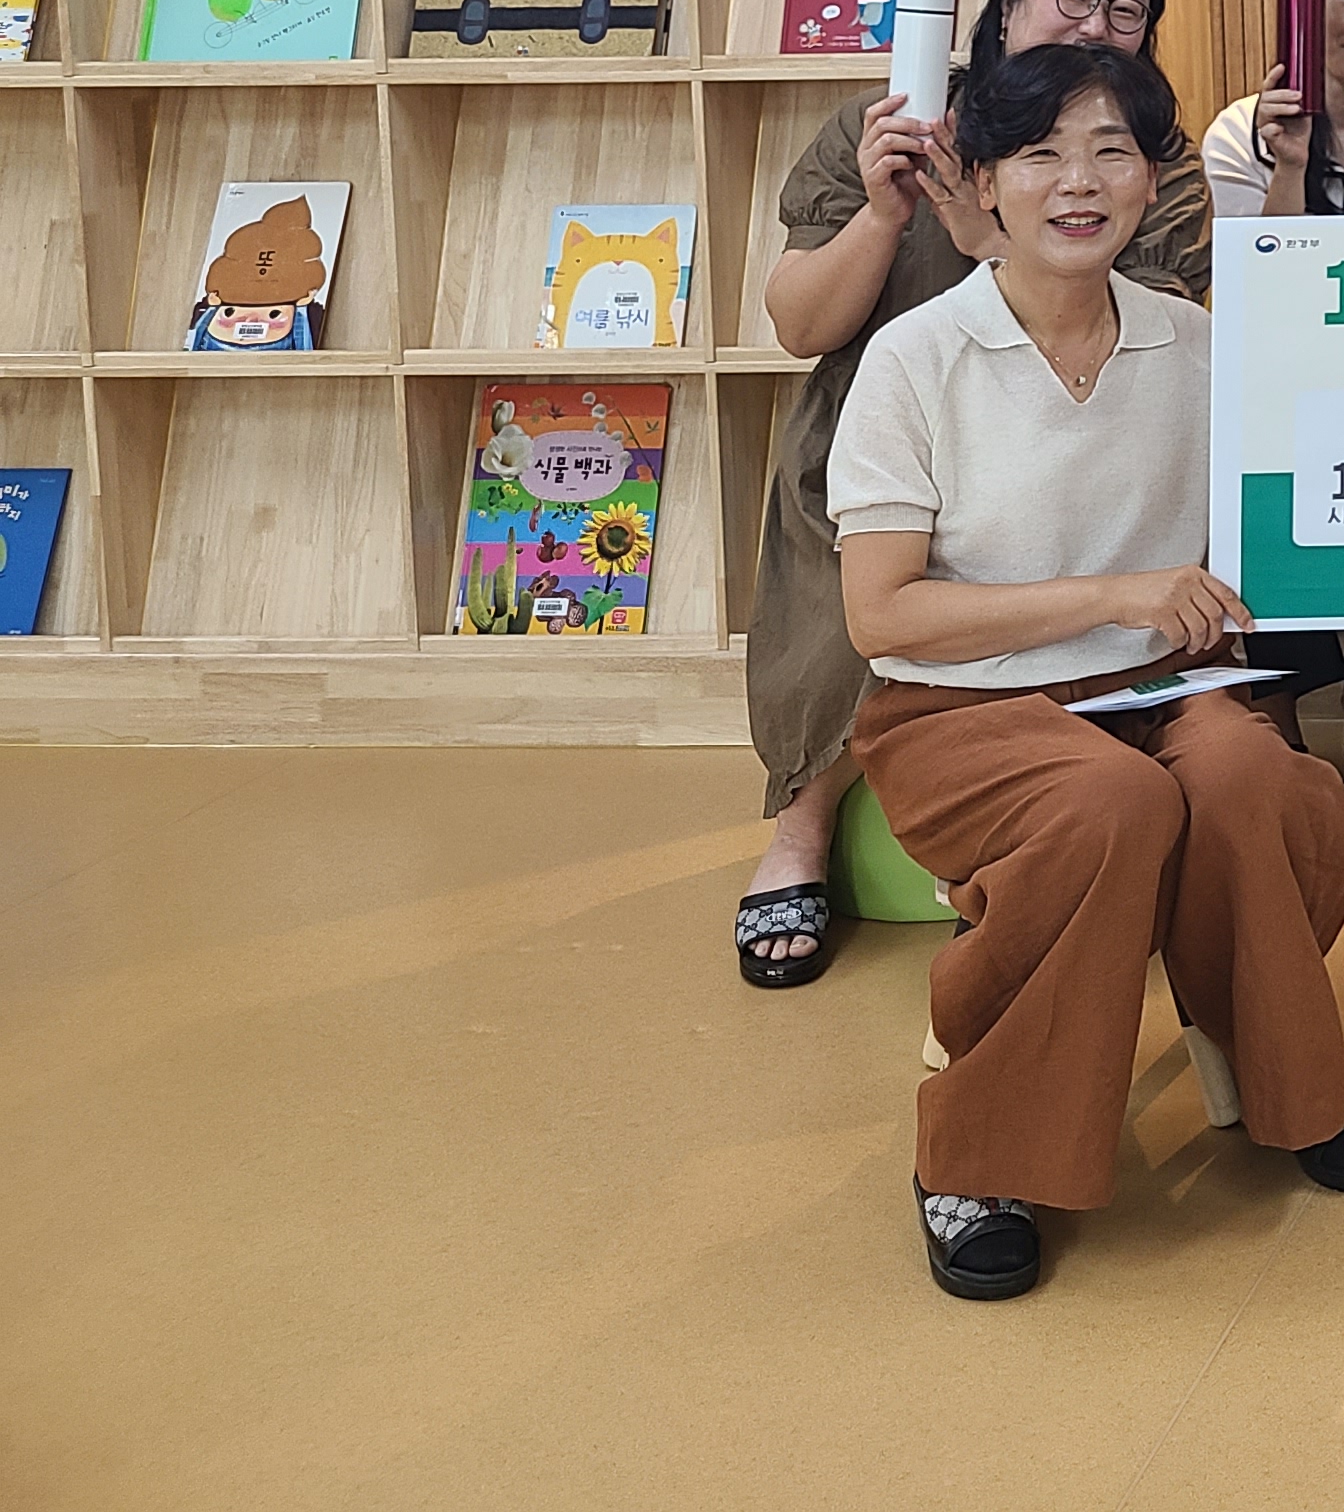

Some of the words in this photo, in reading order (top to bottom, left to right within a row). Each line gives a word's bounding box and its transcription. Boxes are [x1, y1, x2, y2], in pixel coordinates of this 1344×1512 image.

[1285, 238, 1320, 250] 환경부
[255, 250, 276, 276] 똥
[615, 308, 650, 330] 낚시
[534, 456, 570, 484] 식물
[573, 456, 613, 481] 백과
